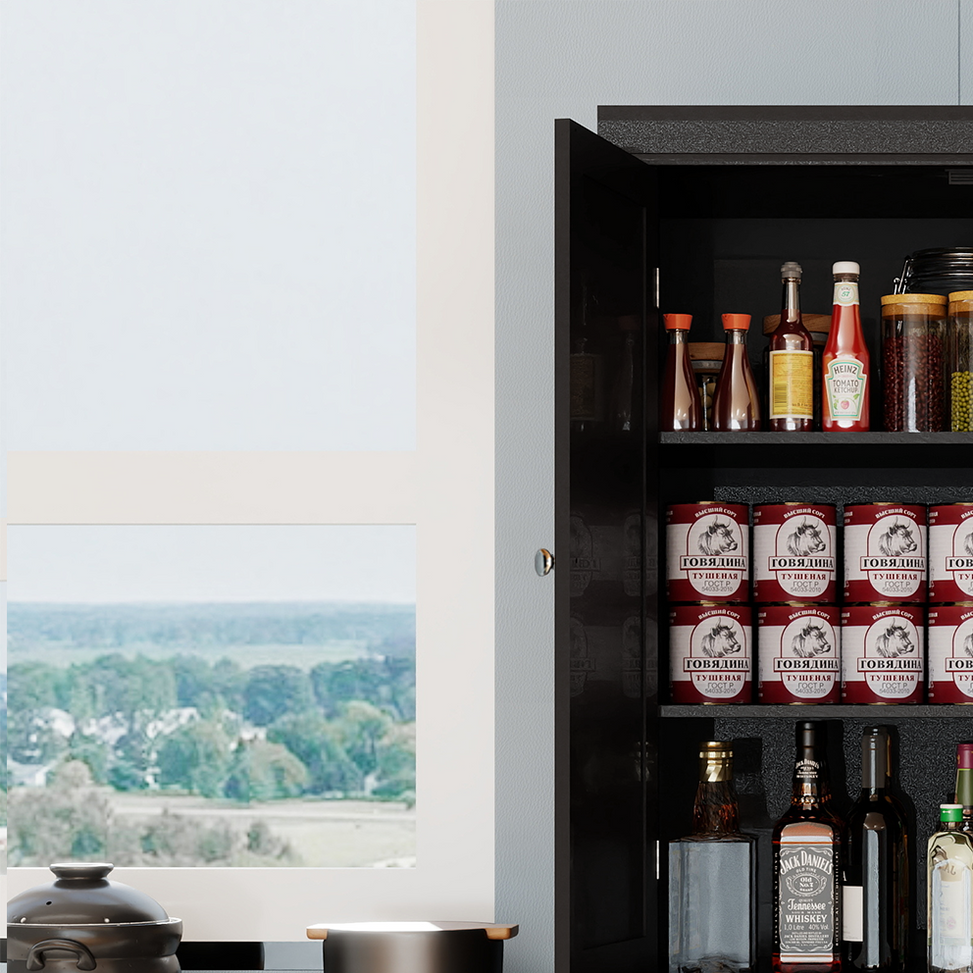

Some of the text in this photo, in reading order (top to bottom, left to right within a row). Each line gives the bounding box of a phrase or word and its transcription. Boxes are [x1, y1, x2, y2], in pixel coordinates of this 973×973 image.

[834, 365, 858, 375] HEINZ
[833, 379, 859, 387] TOMATO
[683, 558, 745, 568] ГОВЯДИНА
[772, 558, 834, 569] ГОВЯДИНА
[863, 558, 924, 569] ГОВЯДИНА
[686, 660, 748, 670] ГОВЯДИНА
[777, 660, 839, 670] ГОВЯДИНА
[860, 660, 922, 670] ГОВЯДИНА
[780, 850, 834, 875] JACK DANIEL'S
[787, 899, 826, 910] Tennessee
